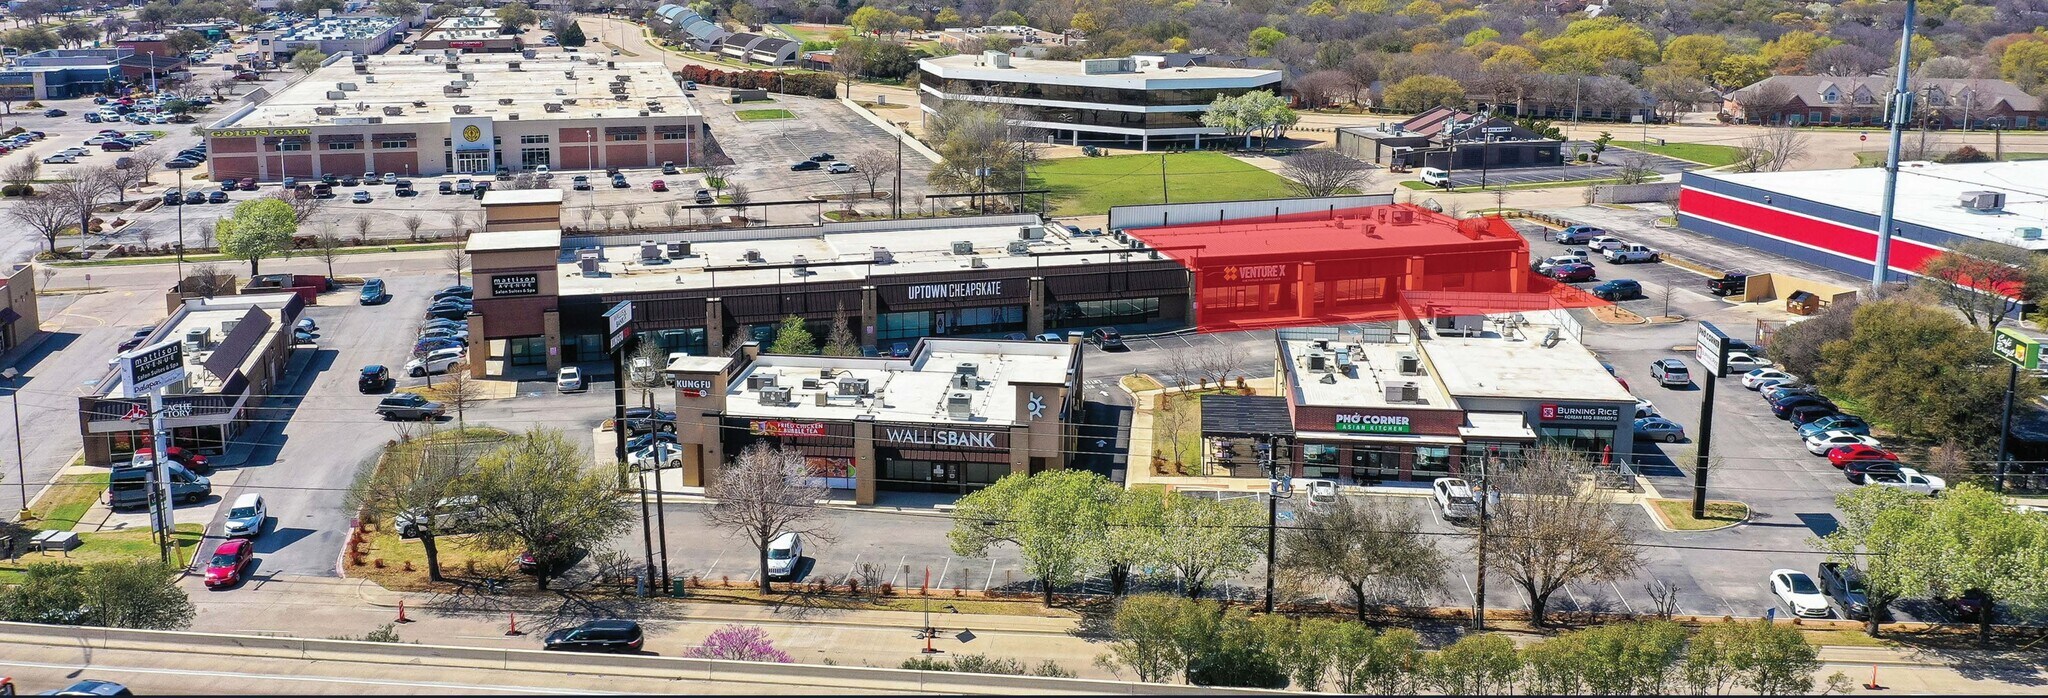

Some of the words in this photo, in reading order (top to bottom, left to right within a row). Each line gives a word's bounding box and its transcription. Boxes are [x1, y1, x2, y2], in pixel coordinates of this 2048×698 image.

[210, 129, 269, 137] GOLD'S
[1239, 266, 1278, 279] VENTURE
[1279, 265, 1286, 276] X
[493, 276, 536, 285] mattison
[908, 284, 947, 299] UPTOWN
[949, 281, 1001, 298] CHEAPSKATE
[134, 345, 178, 366] mattison
[137, 371, 150, 381] Salon
[151, 367, 165, 376] Suites
[676, 380, 699, 388] KUNG
[700, 380, 711, 389] FU
[167, 402, 192, 411] ACHE
[1557, 406, 1596, 415] BURNING
[1597, 408, 1618, 416] RICE
[168, 410, 191, 418] TORY
[1362, 415, 1410, 425] CORNER
[886, 428, 995, 447] WALLISBANK
